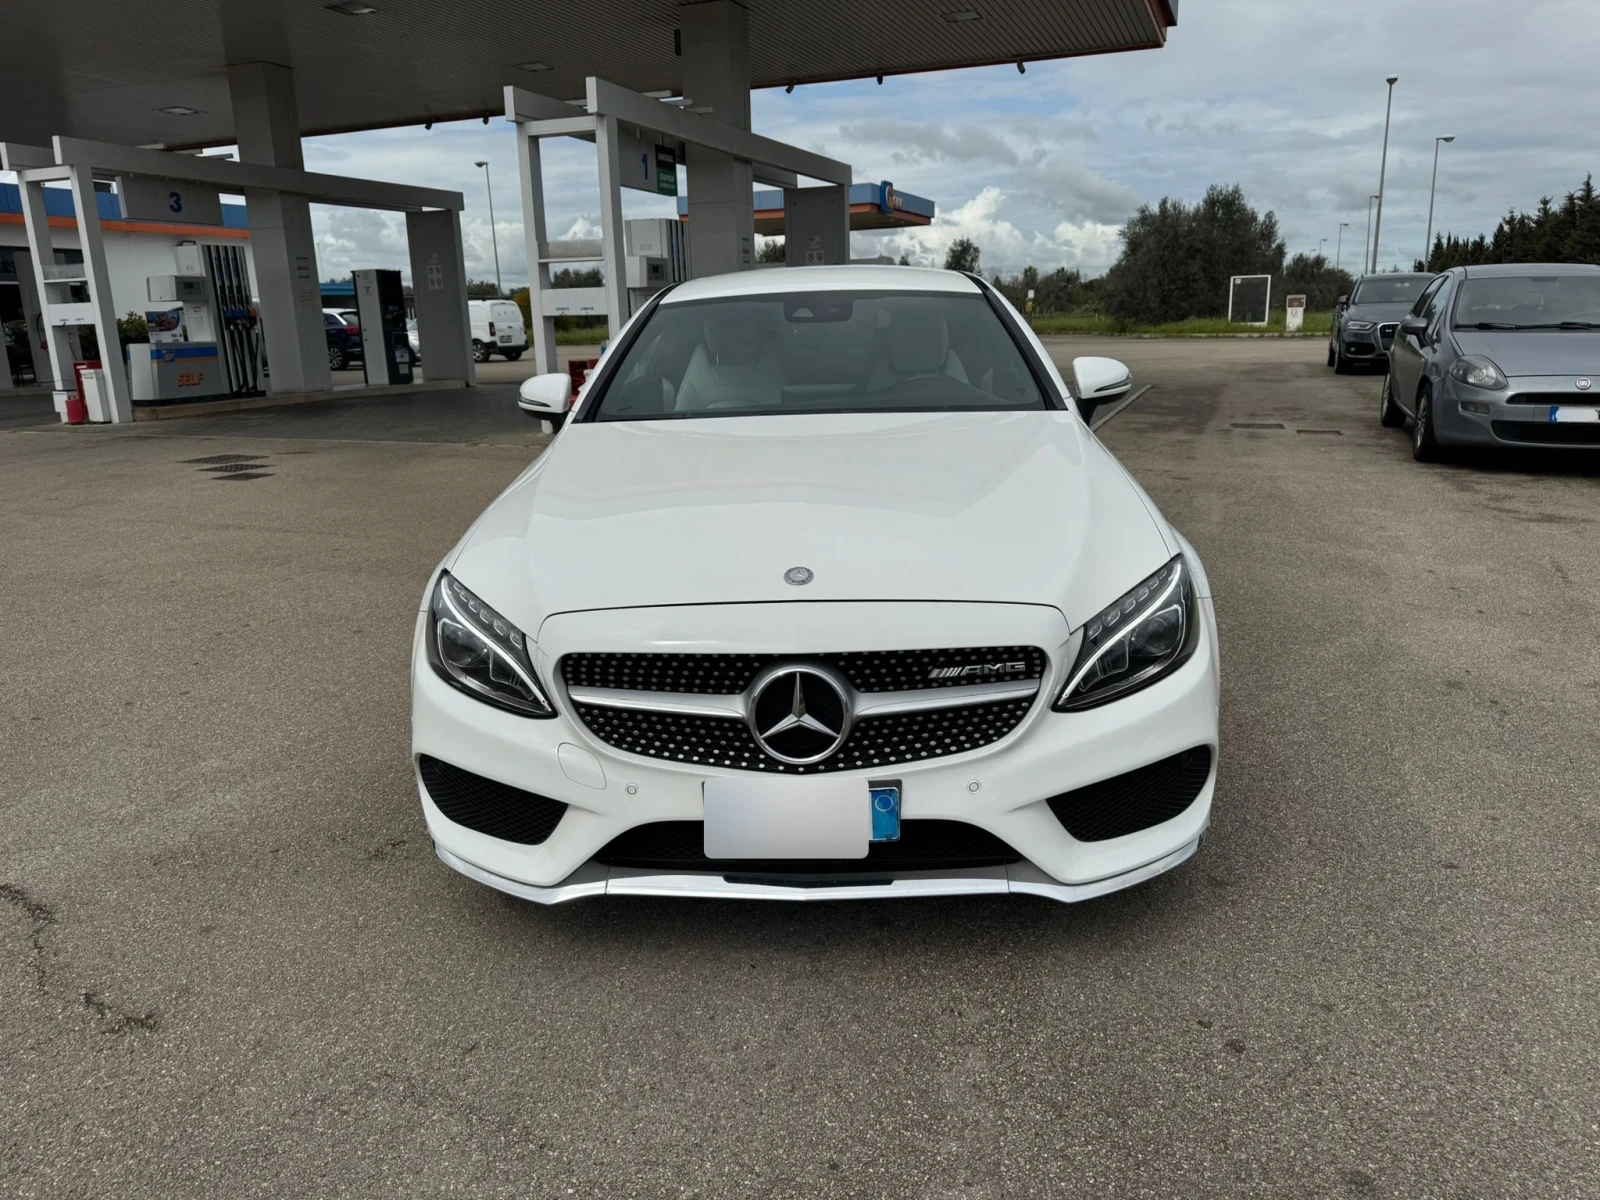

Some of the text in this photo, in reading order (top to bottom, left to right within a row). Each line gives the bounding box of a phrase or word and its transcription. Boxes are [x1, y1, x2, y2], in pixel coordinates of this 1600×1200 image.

[658, 152, 674, 163] DIESEL
[641, 152, 648, 180] 1
[659, 173, 675, 183] SUPER
[168, 191, 183, 213] 3
[177, 372, 204, 387] SELF
[960, 661, 1025, 676] AMG
